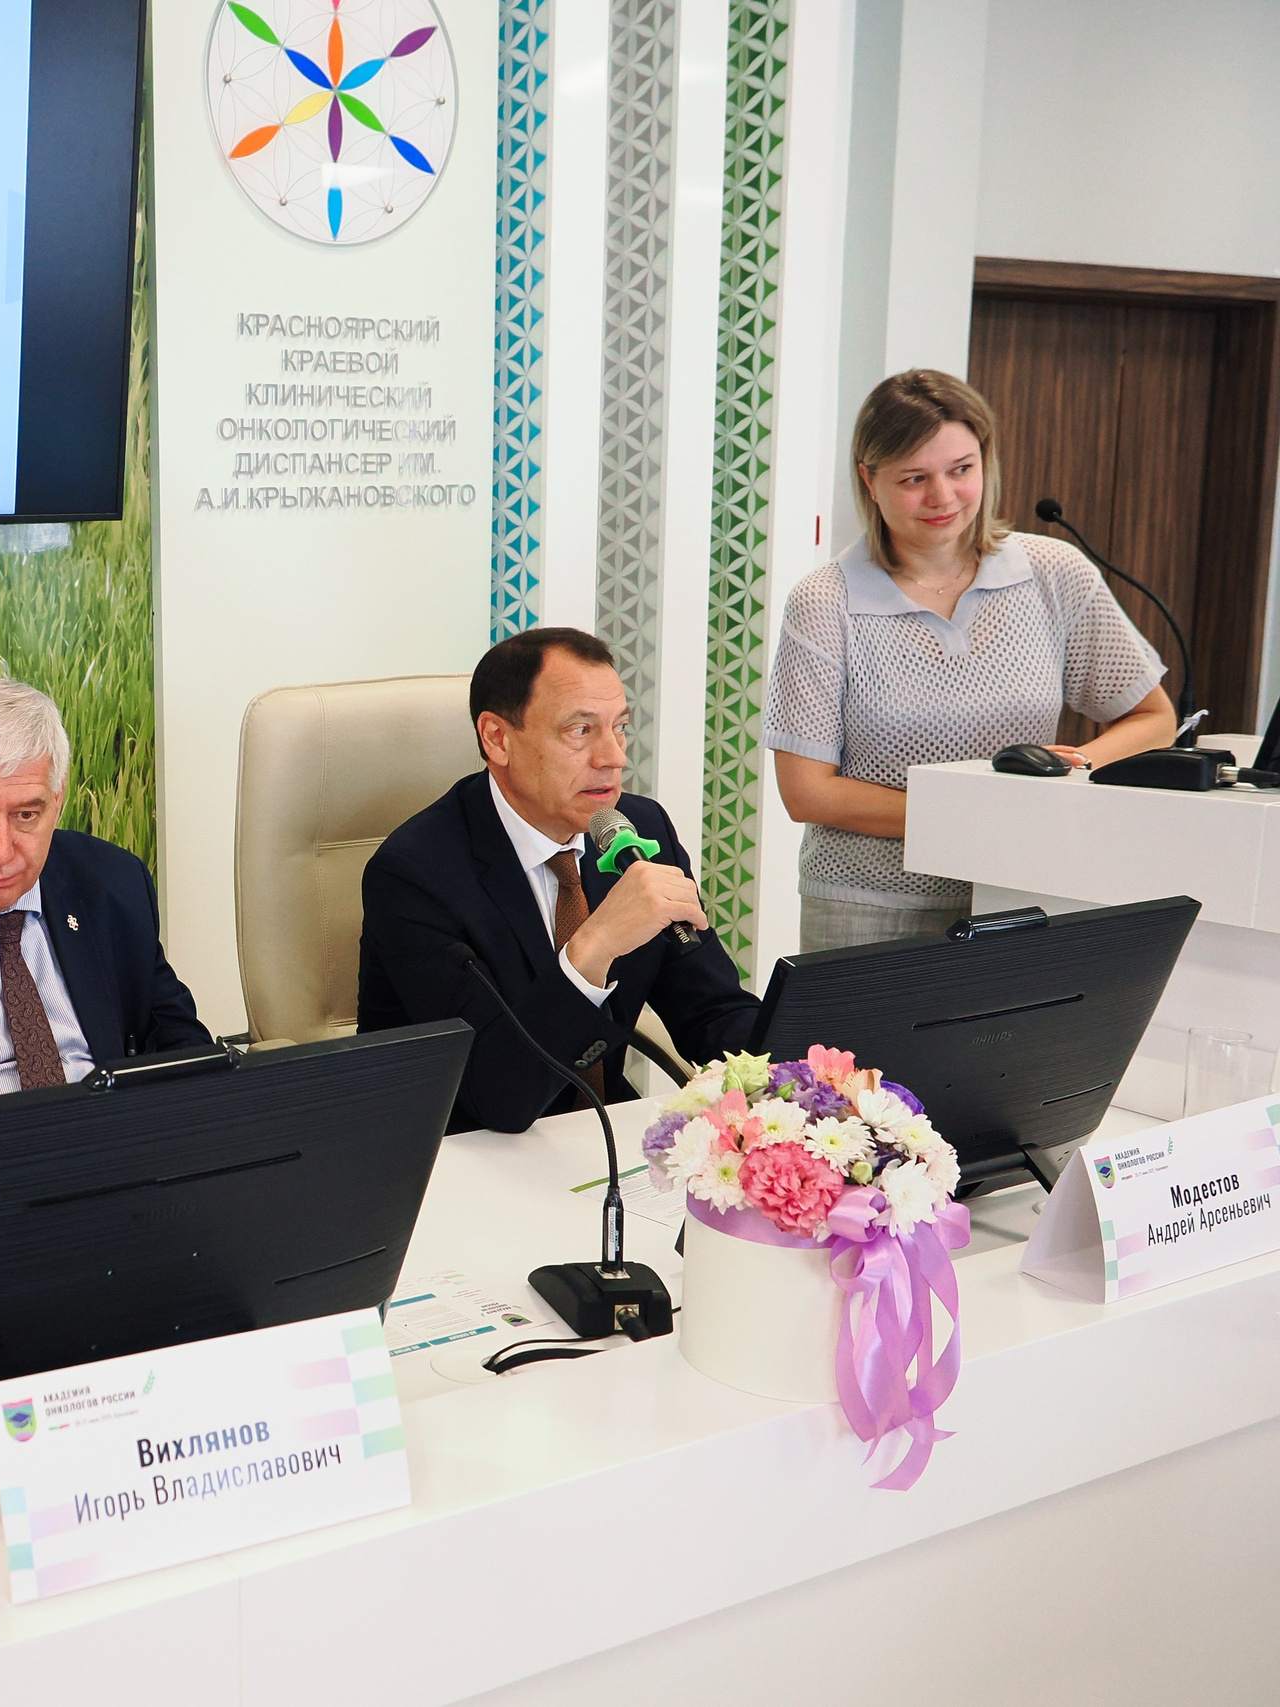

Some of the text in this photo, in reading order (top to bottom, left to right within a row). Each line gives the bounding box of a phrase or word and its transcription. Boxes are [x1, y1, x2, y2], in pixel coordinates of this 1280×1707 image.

[237, 313, 440, 343] КРАСНОЯРСКИЙ
[282, 347, 399, 374] КРАЕВОЙ
[246, 382, 432, 408] КЛИНИЧЕСКИЙ
[217, 415, 456, 441] ОНКОЛОГИЧЕСКИЙ
[233, 452, 441, 479] ДИСПАНСЕР ИМ.
[195, 484, 476, 510] А.И.КРЫЖАНОВСКОГО
[972, 1030, 1014, 1047] PHILIPS
[1114, 1147, 1140, 1160] АКАДЕМИЯ
[1117, 1151, 1165, 1170] ОНКОЛОГОВ РОССИИ
[1170, 1174, 1240, 1208] Модестов
[1147, 1193, 1271, 1246] Андрей Арсеньевич
[43, 1386, 91, 1403] АКАДЕМИЯ
[45, 1390, 136, 1417] ОНКОЛОГОВ РОССИИ
[136, 1420, 270, 1468] Вихлянов
[74, 1444, 342, 1525] Игорь Владиславович
